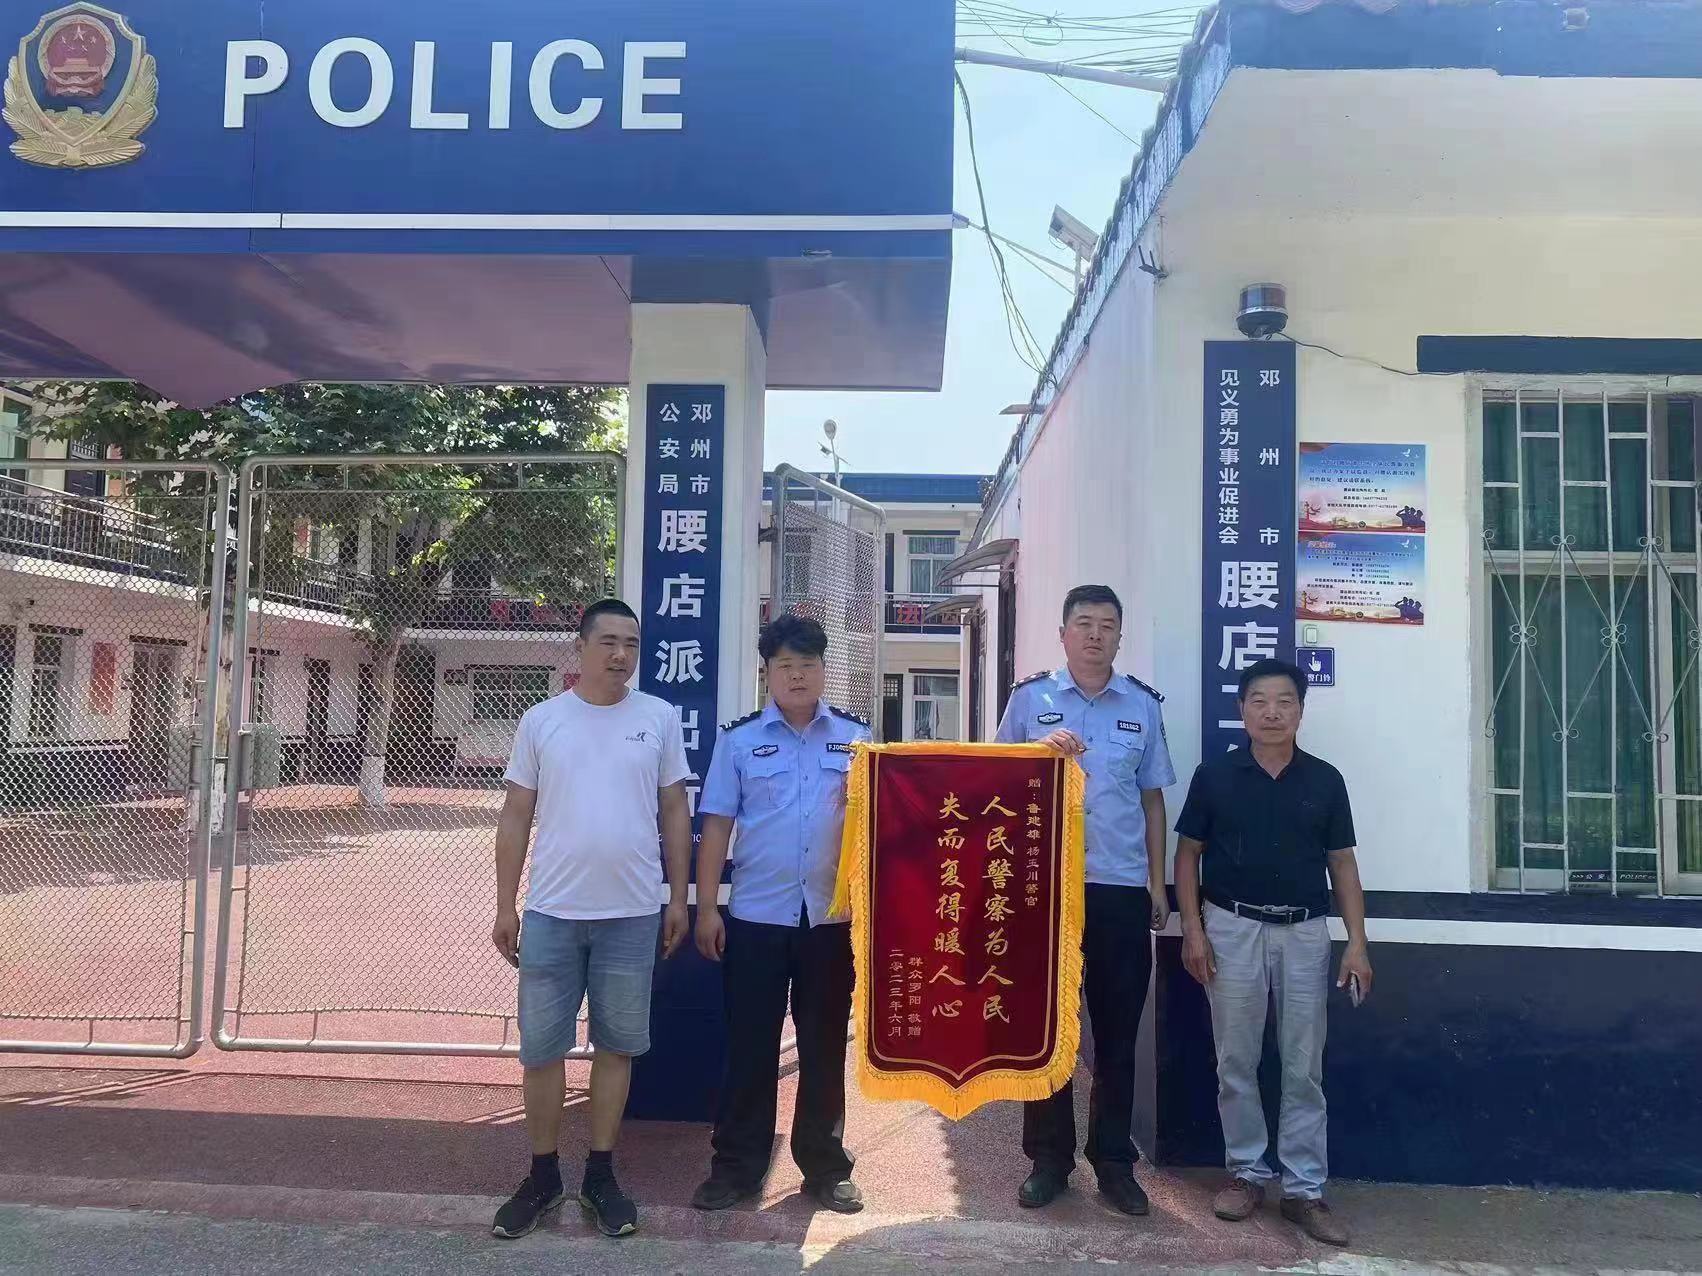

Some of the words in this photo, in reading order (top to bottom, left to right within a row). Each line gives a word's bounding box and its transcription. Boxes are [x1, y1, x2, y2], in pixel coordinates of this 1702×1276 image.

[223, 37, 687, 131] POLICE
[657, 403, 680, 495] 公安局
[690, 403, 712, 494] 邓州市
[1218, 369, 1239, 545] 见义勇为事业促进会
[1259, 369, 1280, 546] 邓州市
[928, 791, 969, 1018] 失而复得暖人心
[978, 795, 1018, 1024] 人民警察为人民
[888, 949, 904, 1037] 二零二三年六月
